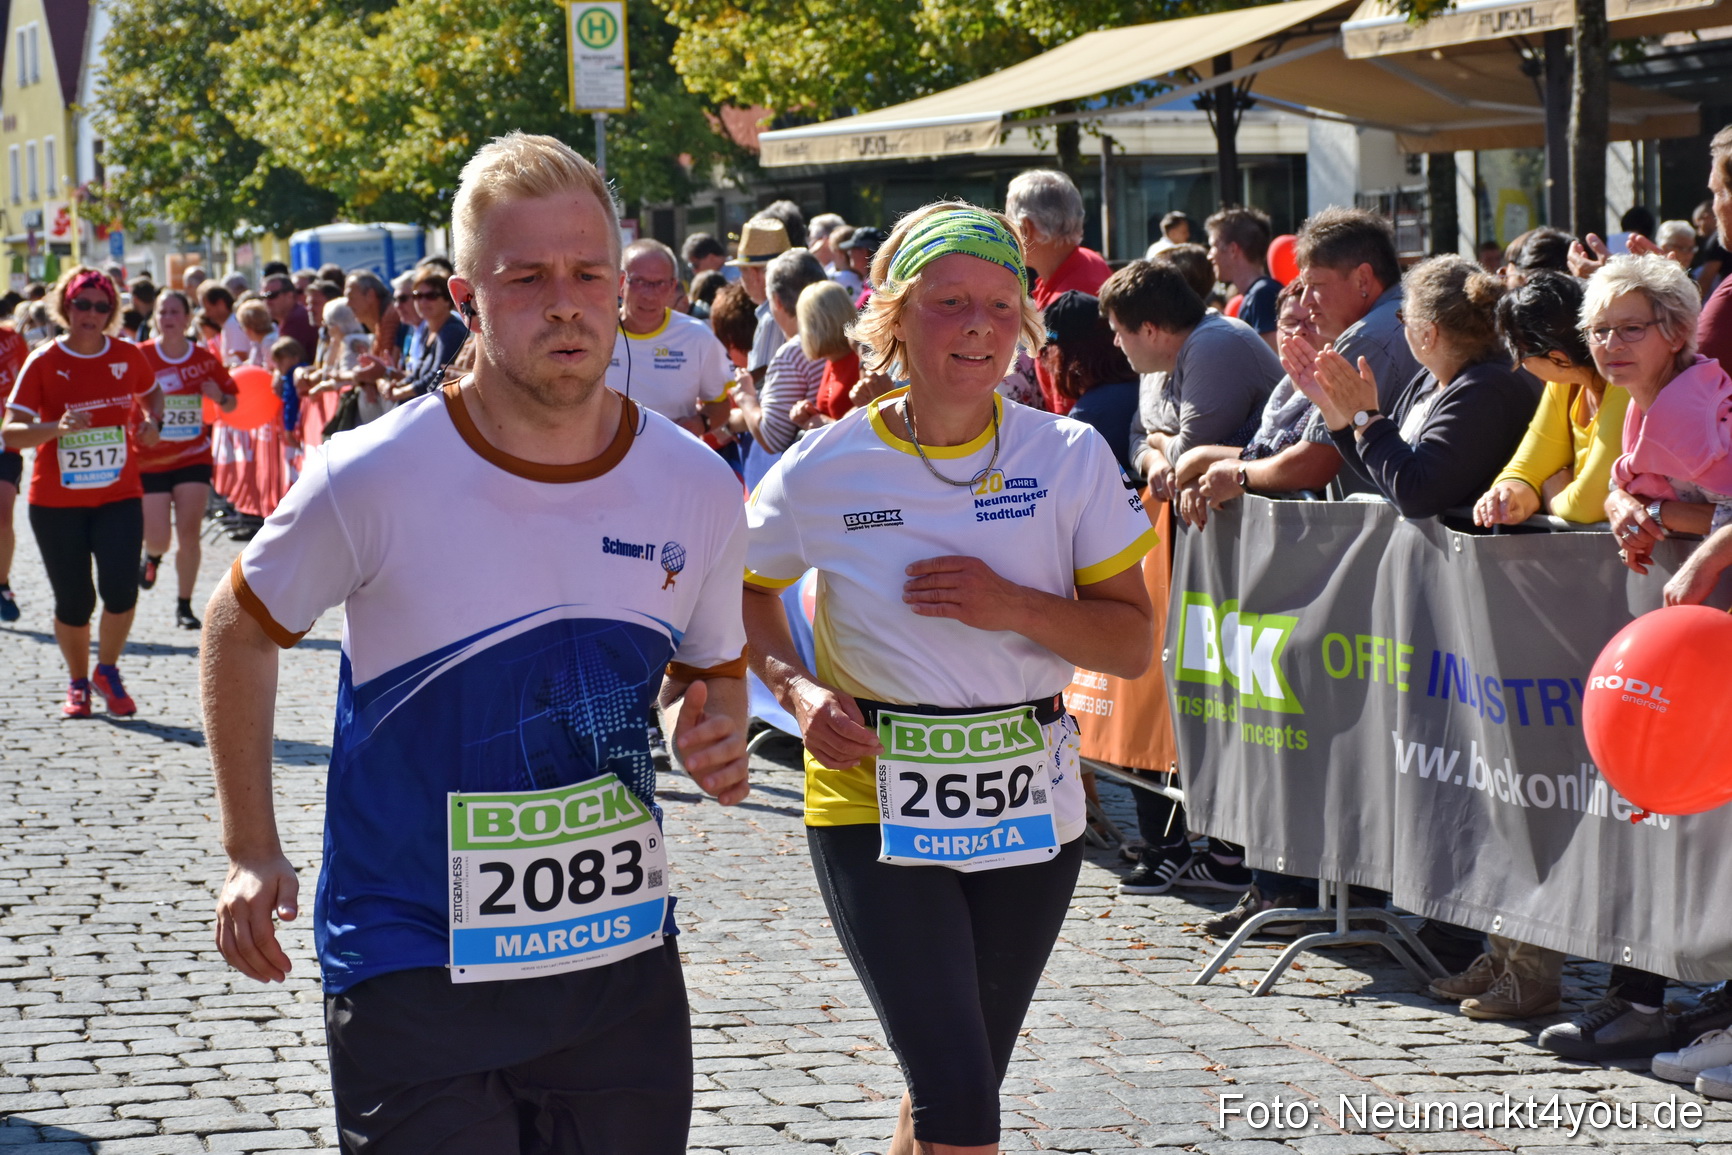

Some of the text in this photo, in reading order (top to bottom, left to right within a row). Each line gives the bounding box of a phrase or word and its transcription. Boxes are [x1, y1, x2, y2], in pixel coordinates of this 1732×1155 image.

[161, 411, 196, 424] 263
[64, 431, 116, 447] BOCK
[66, 448, 117, 468] 2517
[74, 472, 115, 482] MARION
[975, 473, 1036, 495] 20 JAHRE
[974, 489, 1049, 508] Neumarkter
[844, 510, 902, 526] BOCK
[976, 504, 1036, 521] Stadtlauf
[602, 536, 656, 561] Schmer.IT
[1321, 632, 1414, 692] OFFIE
[1096, 698, 1114, 717] 897
[1621, 694, 1667, 713] energie
[892, 716, 1032, 754] BOCK
[899, 765, 1034, 819] 2650
[470, 783, 638, 838] BOCK
[913, 826, 1025, 855] CHRISTA
[479, 840, 643, 915] 2083
[495, 916, 631, 957] MARCUS
